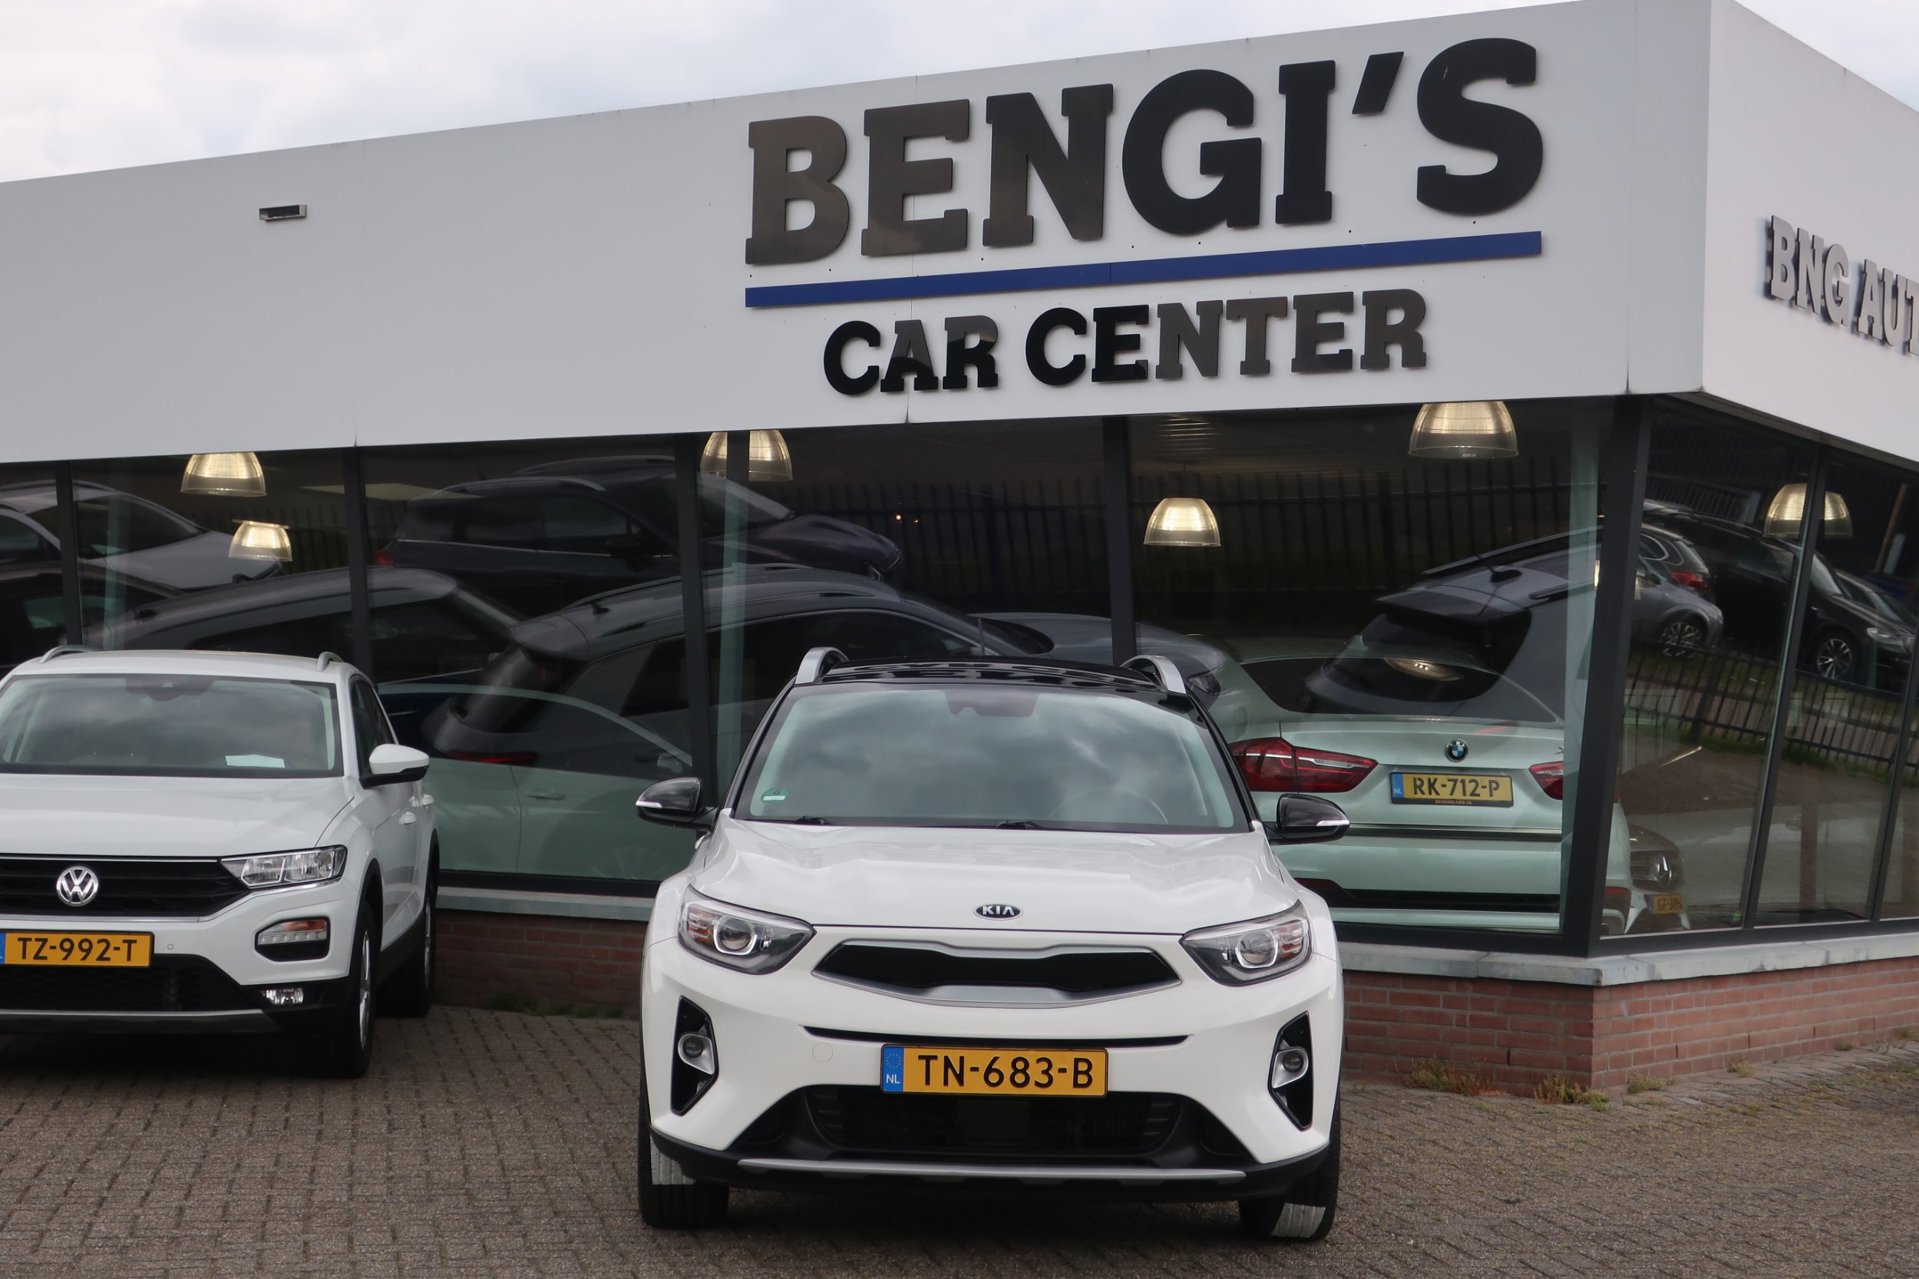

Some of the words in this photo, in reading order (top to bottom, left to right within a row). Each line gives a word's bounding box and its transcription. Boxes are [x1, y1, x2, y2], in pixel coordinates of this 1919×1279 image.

[745, 37, 1543, 266] BENGI'S
[1768, 215, 1850, 327] BNG
[823, 314, 999, 396] CAR
[1025, 288, 1427, 387] CENTER
[1413, 777, 1500, 797] RK-712-P
[982, 905, 1015, 915] KIA
[17, 937, 138, 962] TZ-992-T
[886, 1074, 900, 1084] NL
[918, 1055, 1093, 1089] TN-683-B
